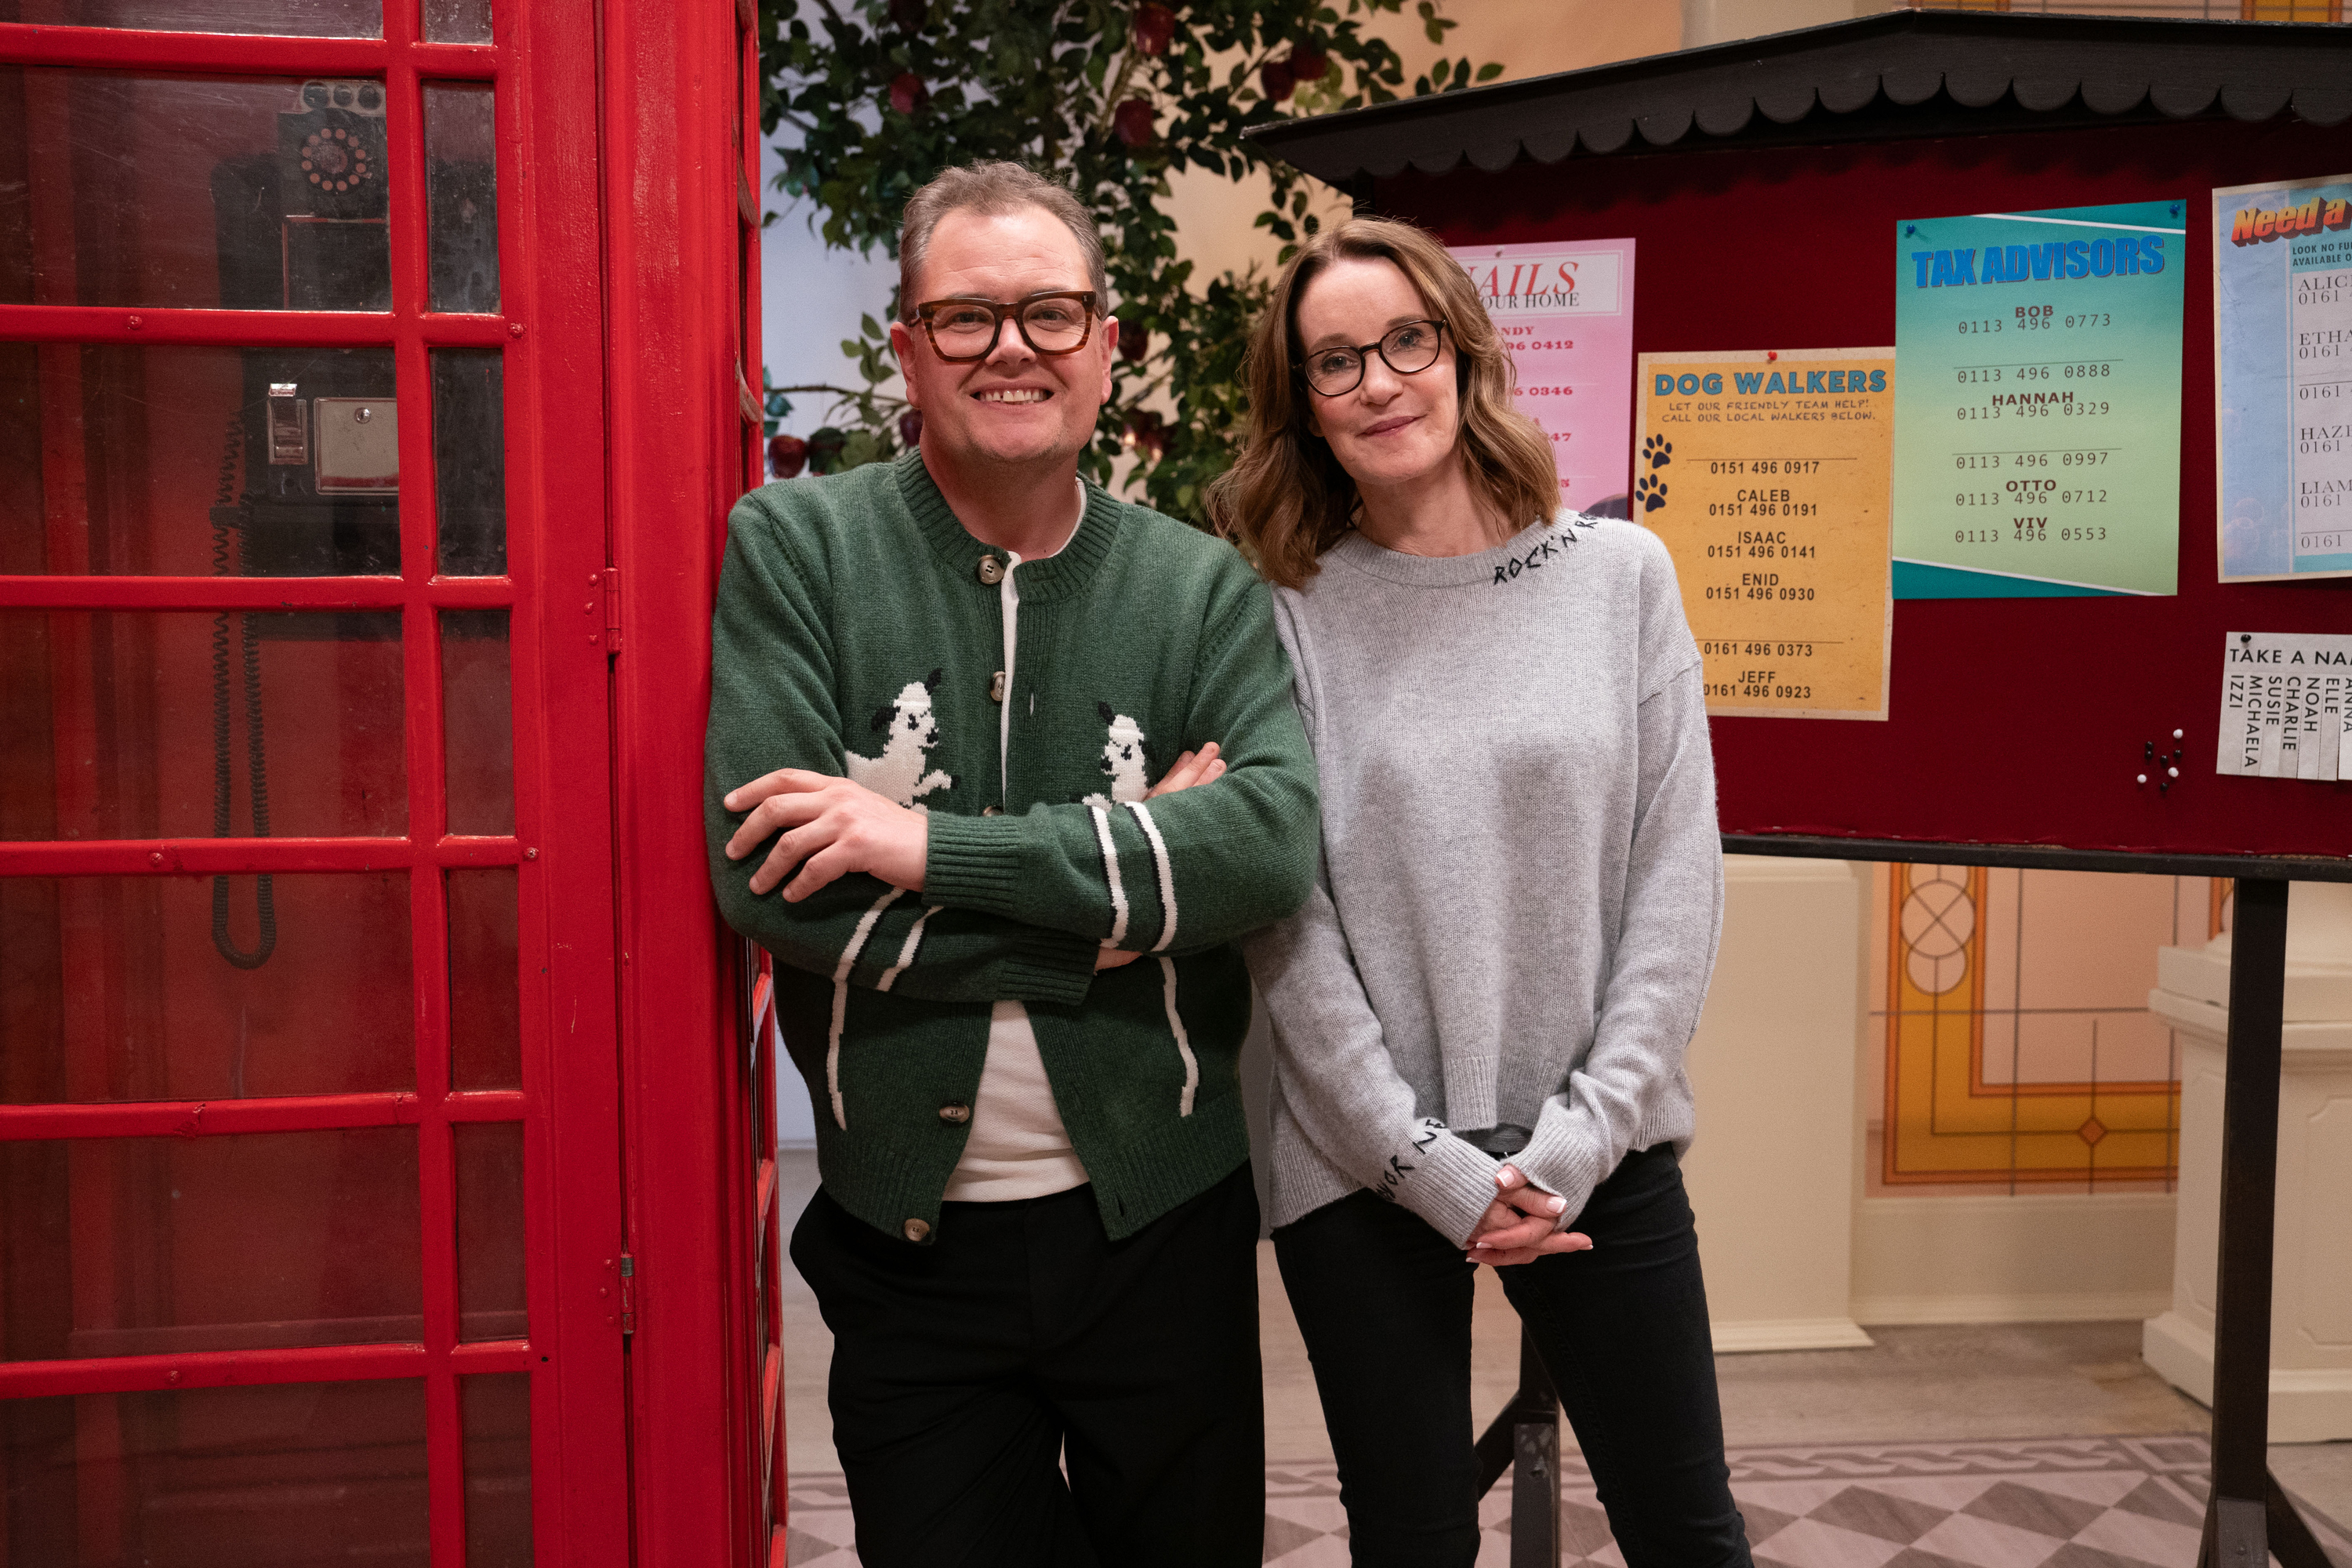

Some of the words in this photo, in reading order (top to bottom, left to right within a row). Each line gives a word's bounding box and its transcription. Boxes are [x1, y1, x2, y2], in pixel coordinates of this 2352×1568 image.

[2230, 197, 2326, 248] Need
[2323, 198, 2351, 232] a
[2292, 244, 2317, 256] LOOK
[2321, 243, 2334, 252] NO
[2339, 241, 2352, 251] FU
[1911, 248, 1977, 289] TAX
[1980, 235, 2165, 284] ADVISORS
[2292, 255, 2341, 267] AVAILABLE
[2298, 274, 2352, 292] ALIC
[1525, 292, 1580, 308] HOME
[2299, 290, 2339, 305] 0161
[2015, 305, 2054, 318] BOB
[1958, 319, 2002, 334] 0113
[2017, 318, 2051, 330] 496
[2065, 314, 2111, 328] 0773
[1531, 340, 1574, 350] 0412
[2299, 344, 2339, 360] 0161
[1958, 369, 2002, 383] 0113
[2016, 367, 2050, 380] 496
[2064, 364, 2111, 378] 0888
[1655, 372, 1723, 396] DOG
[1733, 369, 1886, 395] WALKERS
[1529, 386, 1573, 396] 0346
[1992, 391, 2074, 406] HANNAH
[2299, 385, 2340, 400] 0161
[1669, 402, 1691, 412] LET
[1698, 401, 1720, 411] OUR
[1726, 401, 1789, 411] FRIENDLY
[1796, 400, 1828, 410] TEAM
[1835, 399, 1869, 409] HELP!
[1957, 406, 2001, 420] 0113
[2016, 404, 2049, 417] 496
[2063, 401, 2110, 416] 0329
[1662, 413, 1691, 423] CALL
[1698, 413, 1721, 423] OUR
[1726, 412, 1765, 422] LOCAL
[1771, 412, 1825, 422] WALKERS
[1831, 411, 1875, 421] BELOW.
[2300, 440, 2340, 454] 0161
[1711, 462, 1744, 474] 0151
[1751, 461, 1777, 474] 496
[1784, 461, 1820, 474] 0917
[1956, 456, 2000, 470] 0113
[2015, 454, 2049, 467] 496
[2063, 452, 2108, 466] 0997
[2005, 479, 2057, 492] OTTO
[2300, 479, 2352, 495] LIAM
[1737, 489, 1790, 503] CALEB
[1955, 492, 1999, 506] 0113
[2014, 491, 2048, 504] 496
[2062, 489, 2107, 503] 0712
[2300, 494, 2341, 508] 0161
[1709, 503, 1743, 516] 0151
[1750, 503, 1776, 516] 496
[1783, 503, 1817, 516] 0191
[2013, 517, 2048, 529] VIV
[1737, 532, 1786, 544] ISAAC
[1955, 529, 1999, 543] 0113
[2013, 528, 2047, 542] 496
[2061, 528, 2107, 541] 0553
[2301, 535, 2342, 549] 0161
[1708, 545, 1741, 558] 0151
[1748, 546, 1774, 558] 496
[1781, 546, 1816, 558] 0141
[1742, 573, 1779, 586] ENID
[1706, 587, 1740, 600] 0151
[1747, 587, 1773, 600] 496
[1779, 588, 1815, 601] 0930
[1704, 642, 1738, 655] 0161
[1744, 643, 1771, 655] 496
[1777, 644, 1813, 656] 0373
[2230, 648, 2282, 663] TAKE
[2290, 650, 2305, 664] A
[2314, 651, 2352, 666] NA
[1738, 670, 1776, 684] JEFF
[1704, 684, 1737, 696] 0161
[1743, 684, 1769, 697] 496
[1776, 685, 1811, 699] 0923
[2229, 675, 2245, 708] IZZI
[2325, 678, 2340, 714] ELLE
[2266, 676, 2282, 725] SUSIE
[2303, 677, 2321, 732] NOAH
[2282, 677, 2301, 750] CHARLIE
[2245, 675, 2263, 768] MICHAELA
